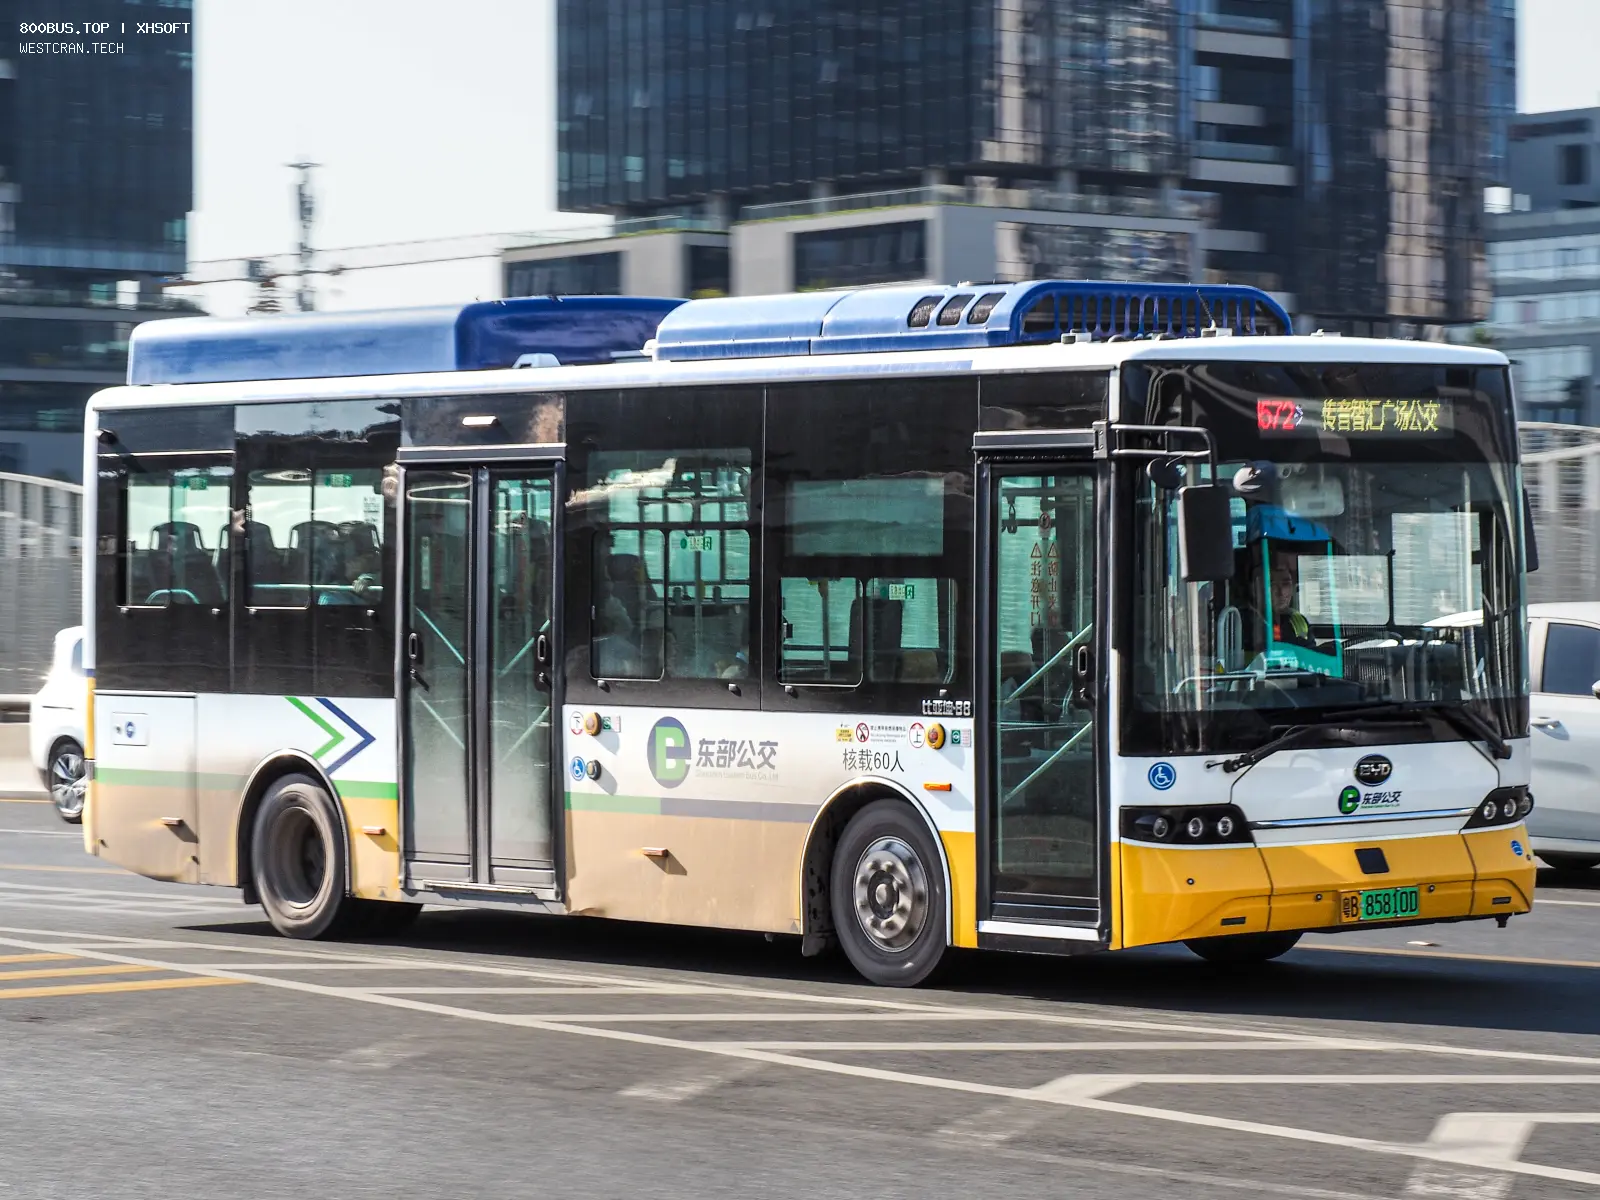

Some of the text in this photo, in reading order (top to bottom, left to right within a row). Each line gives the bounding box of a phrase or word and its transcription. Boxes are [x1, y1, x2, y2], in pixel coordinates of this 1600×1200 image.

[913, 730, 922, 744] 上
[695, 737, 779, 770] 东部公交
[842, 748, 905, 773] 核载60人
[1359, 763, 1391, 776] BYD
[1361, 791, 1402, 804] 东部公交
